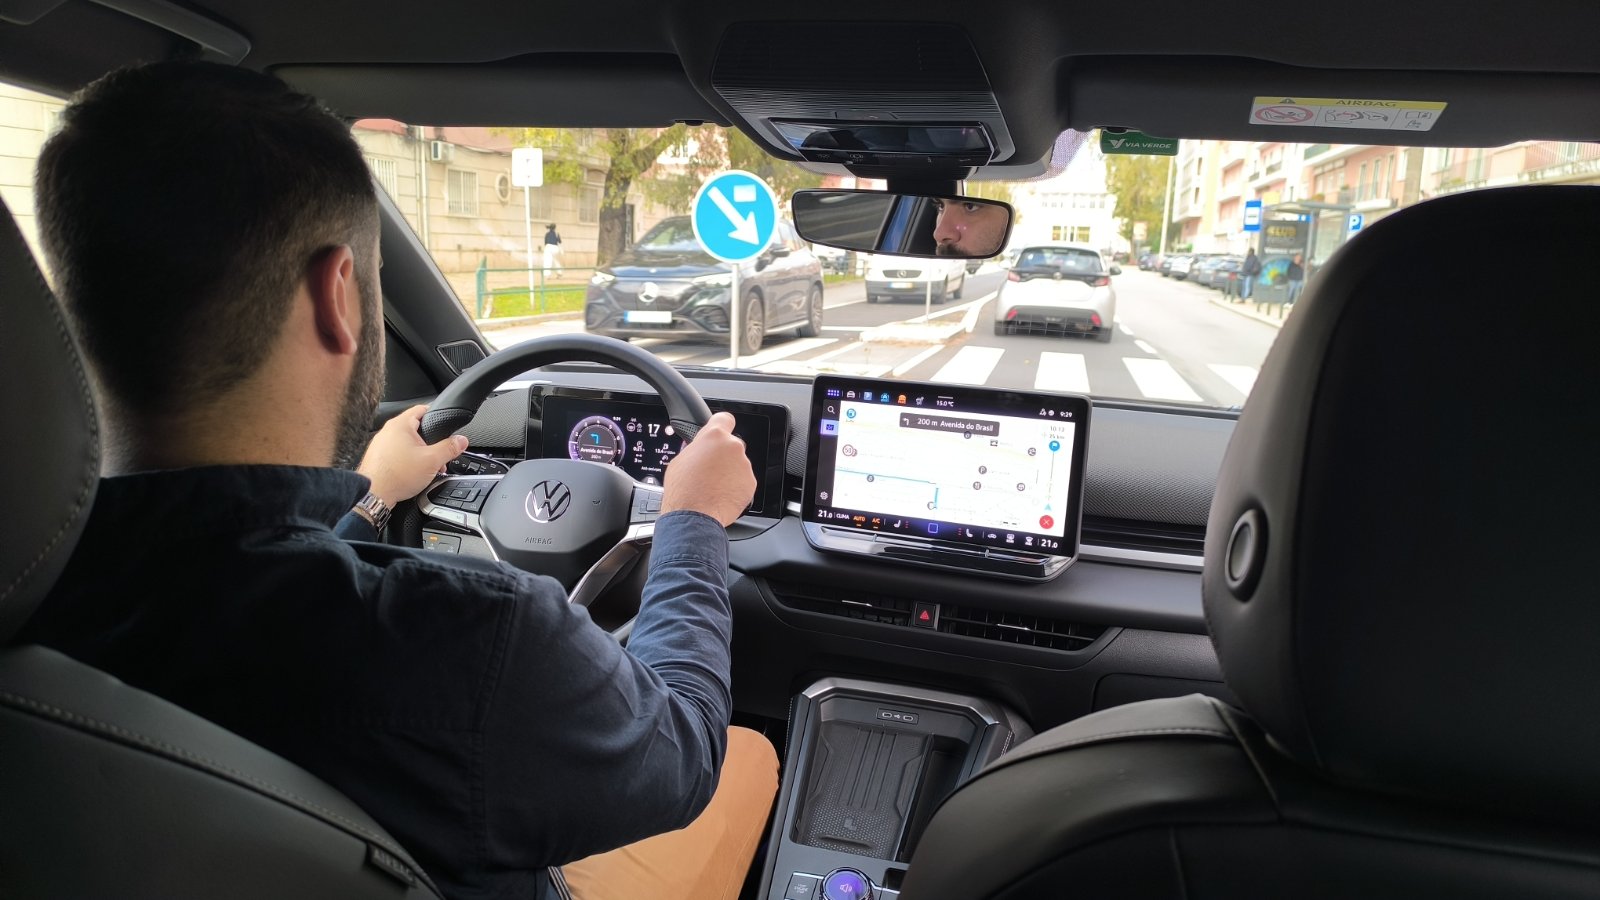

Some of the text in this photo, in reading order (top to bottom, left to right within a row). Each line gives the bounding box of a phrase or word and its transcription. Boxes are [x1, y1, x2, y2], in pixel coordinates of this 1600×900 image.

[1349, 215, 1361, 230] P
[648, 424, 660, 434] 17
[917, 418, 930, 426] 200
[940, 420, 965, 429] Avenida
[966, 422, 974, 430] do
[975, 423, 994, 432] Brasil
[818, 509, 833, 519] 21.0
[525, 537, 553, 545] AIRBAG
[1041, 538, 1058, 549] 21.0
